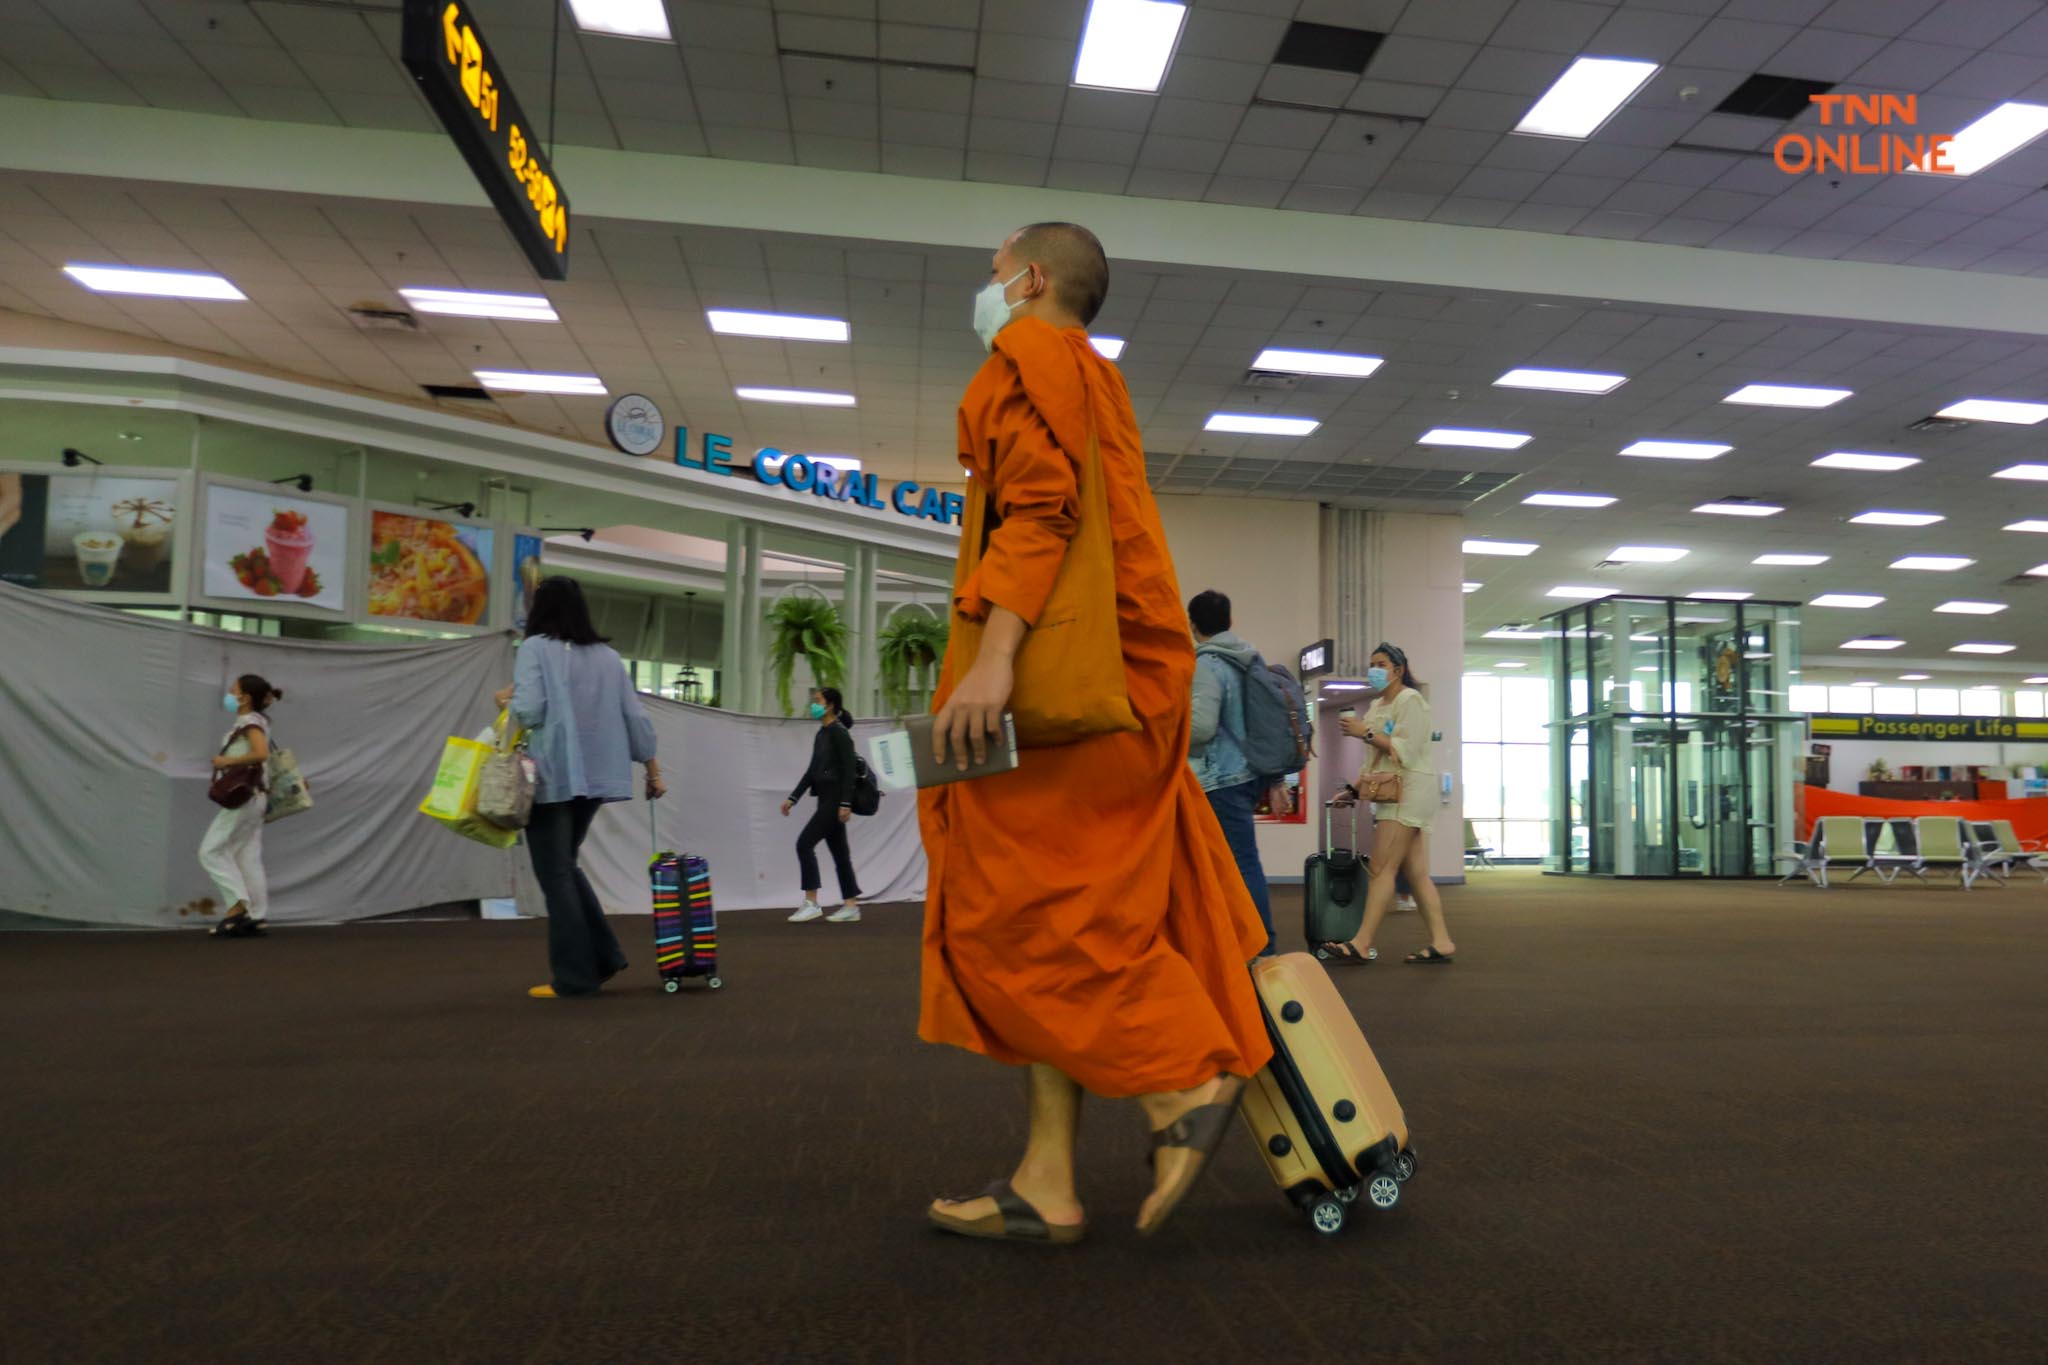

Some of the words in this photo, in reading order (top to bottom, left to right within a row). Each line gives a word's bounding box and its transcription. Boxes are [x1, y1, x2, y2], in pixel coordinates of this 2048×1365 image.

[480, 71, 498, 132] 51
[674, 425, 733, 476] LE
[753, 447, 886, 510] CORAL
[892, 480, 965, 527] CAF
[1861, 717, 1968, 739] Passenger
[1975, 719, 2014, 737] Life
